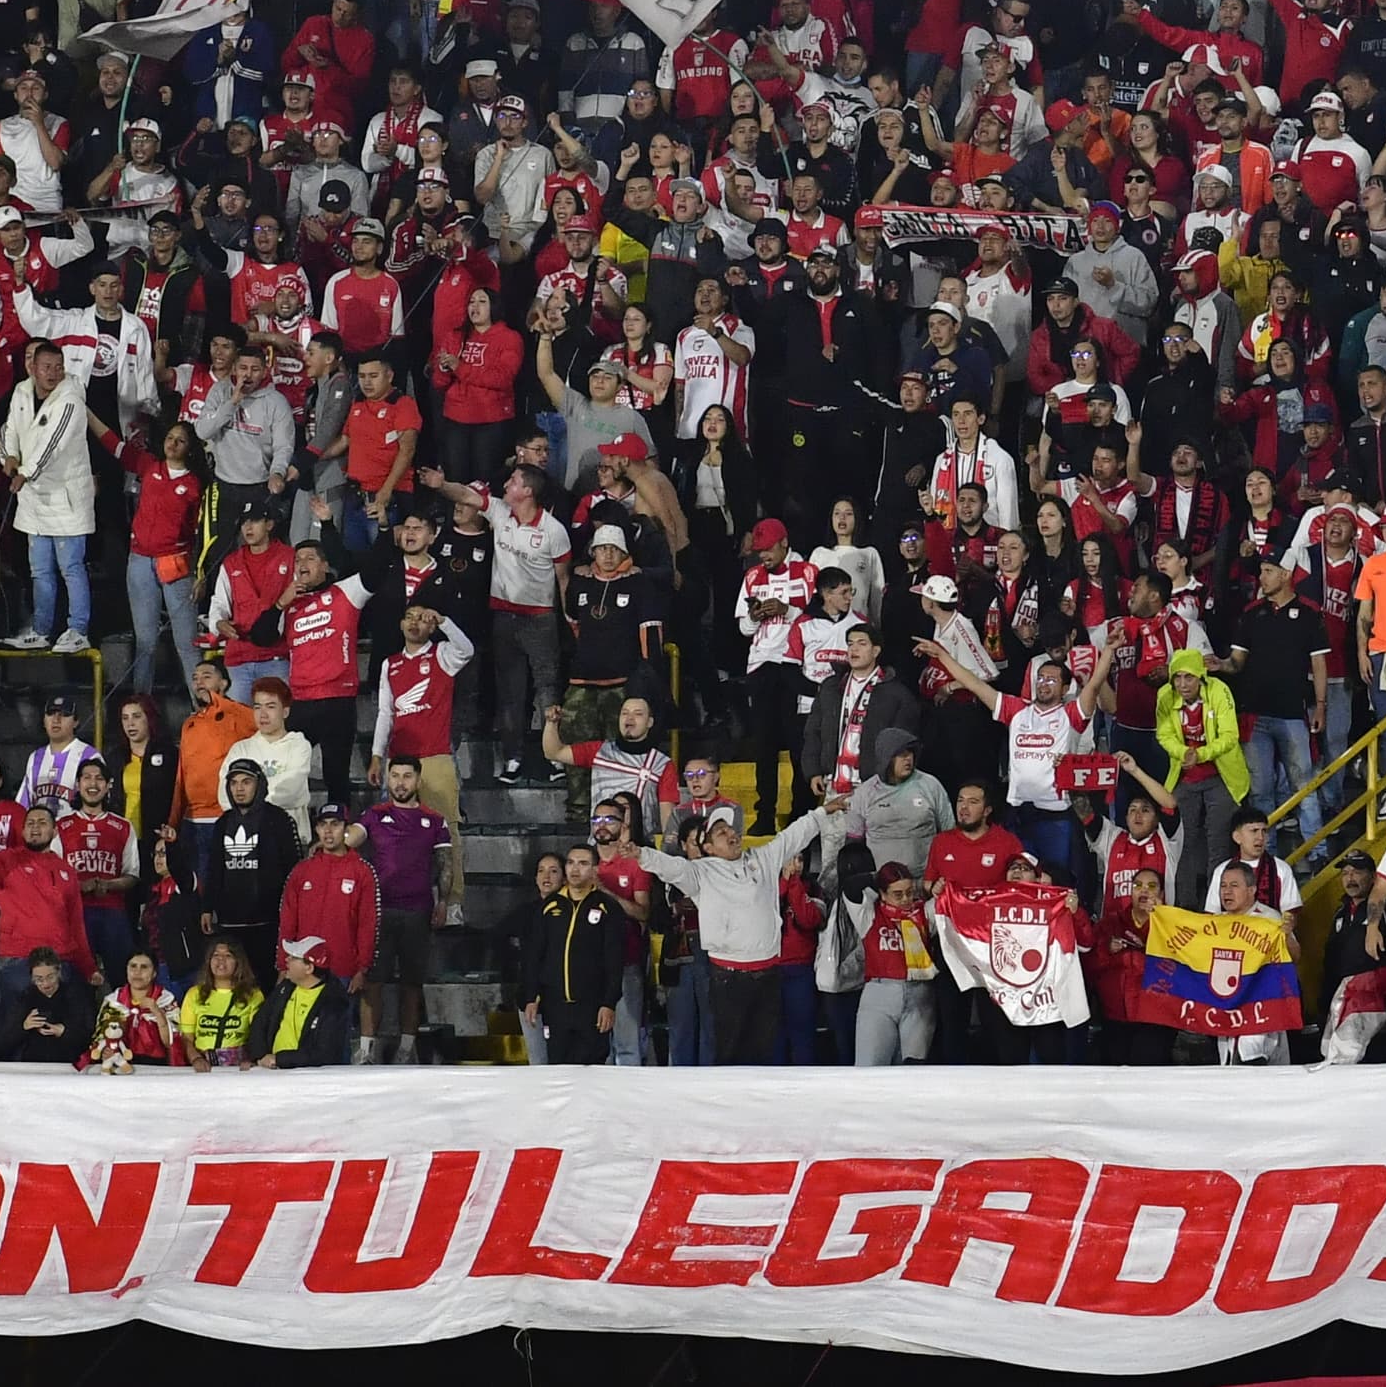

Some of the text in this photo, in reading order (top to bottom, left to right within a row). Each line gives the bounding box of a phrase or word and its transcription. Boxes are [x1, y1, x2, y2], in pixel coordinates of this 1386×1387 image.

[294, 614, 332, 630] Colanta
[1016, 736, 1053, 746] Colanta
[1014, 750, 1047, 761] BetPlay
[1073, 767, 1115, 788] FE
[66, 850, 117, 866] CERVEZA
[224, 857, 259, 870] adidas
[186, 1150, 481, 1295] TU
